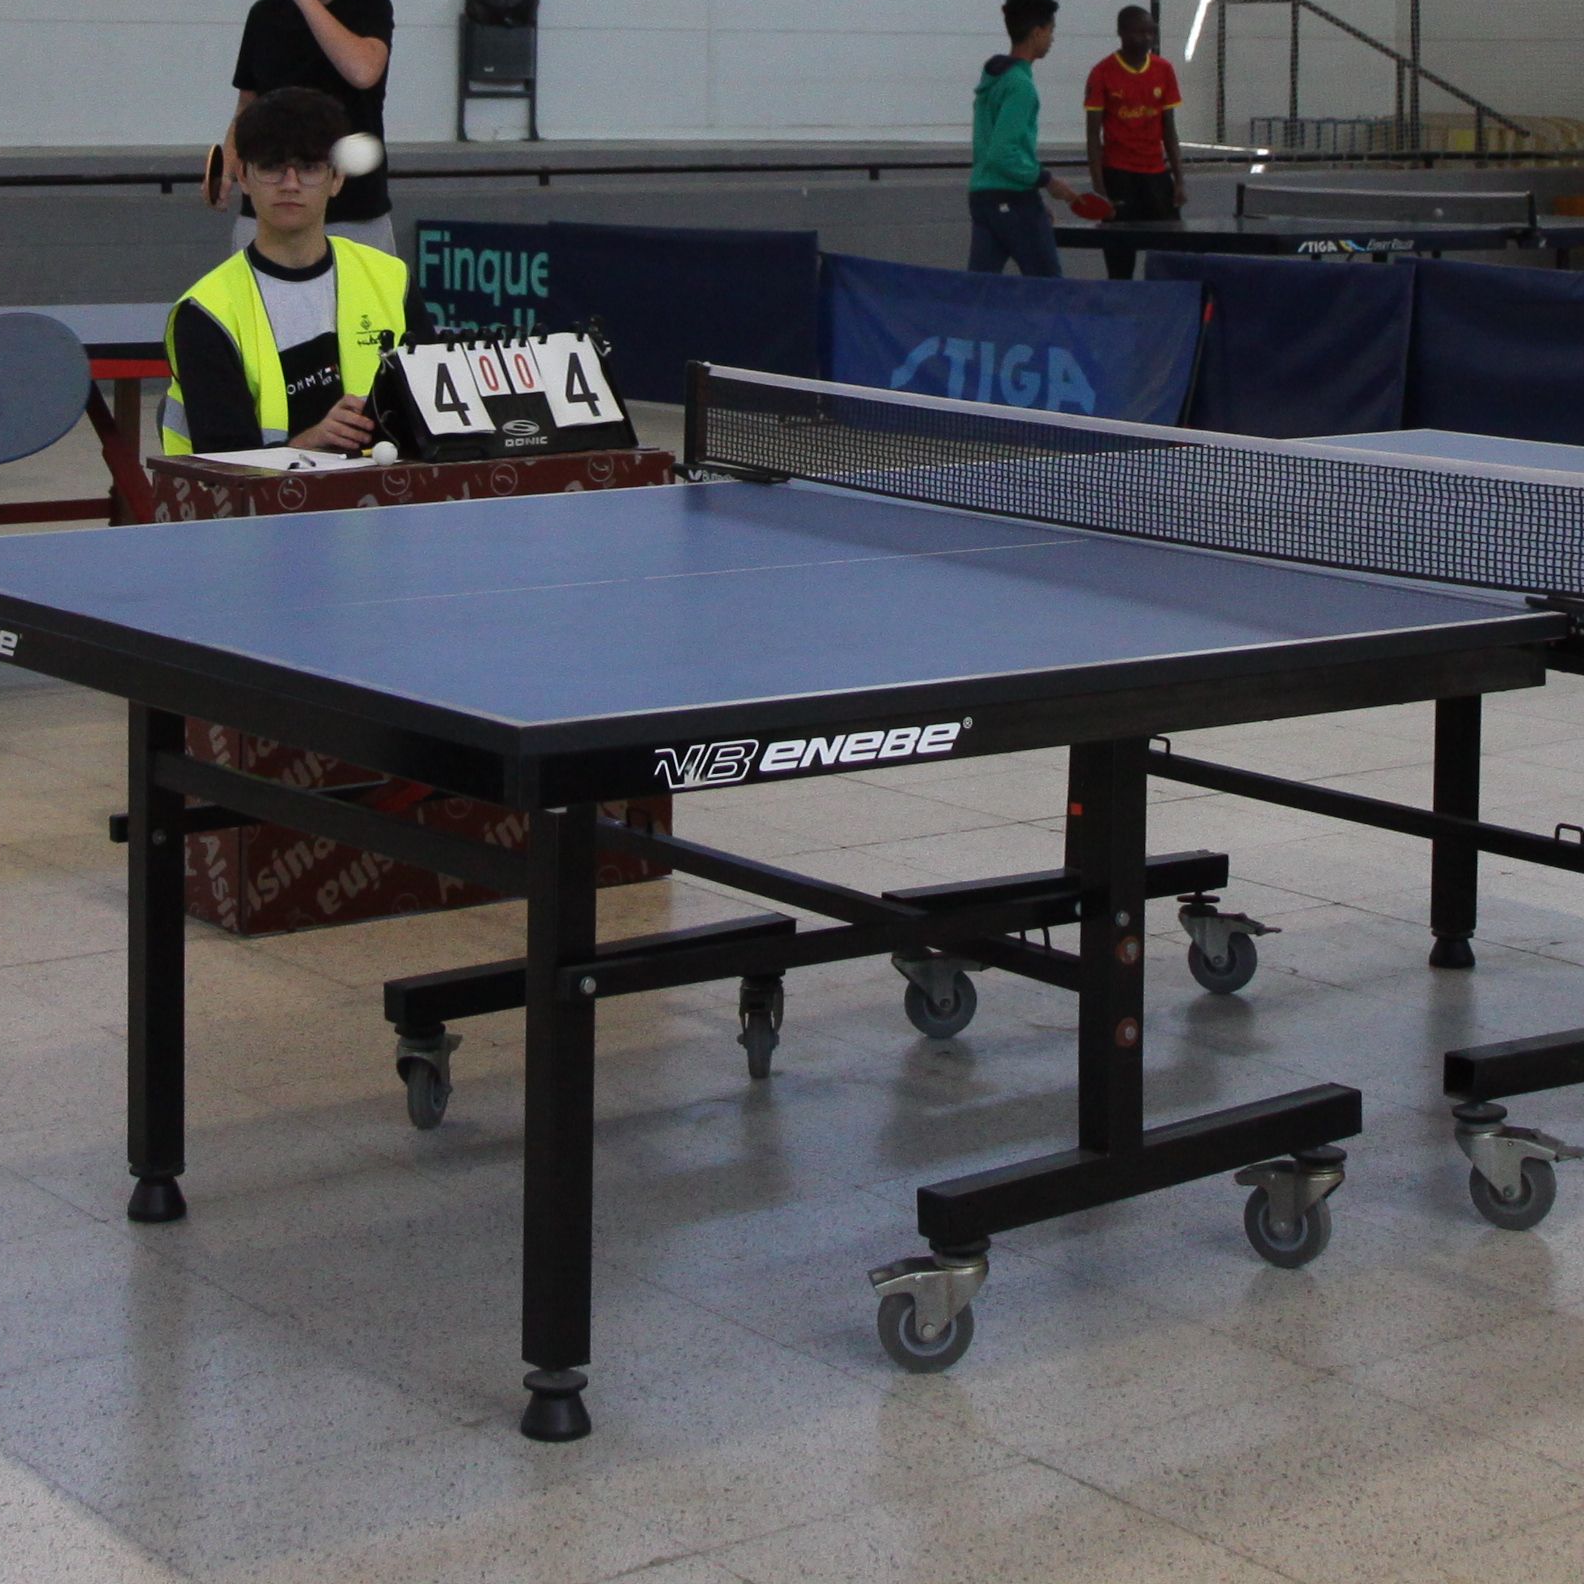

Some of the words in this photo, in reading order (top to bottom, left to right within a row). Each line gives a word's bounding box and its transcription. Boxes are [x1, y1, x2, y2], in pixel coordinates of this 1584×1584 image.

[1298, 240, 1338, 253] STIGA
[287, 368, 324, 395] OMMY
[435, 363, 473, 427] 4
[479, 355, 499, 392] 0
[514, 353, 534, 389] 0
[565, 352, 602, 417] 4
[889, 335, 1097, 417] STIGA
